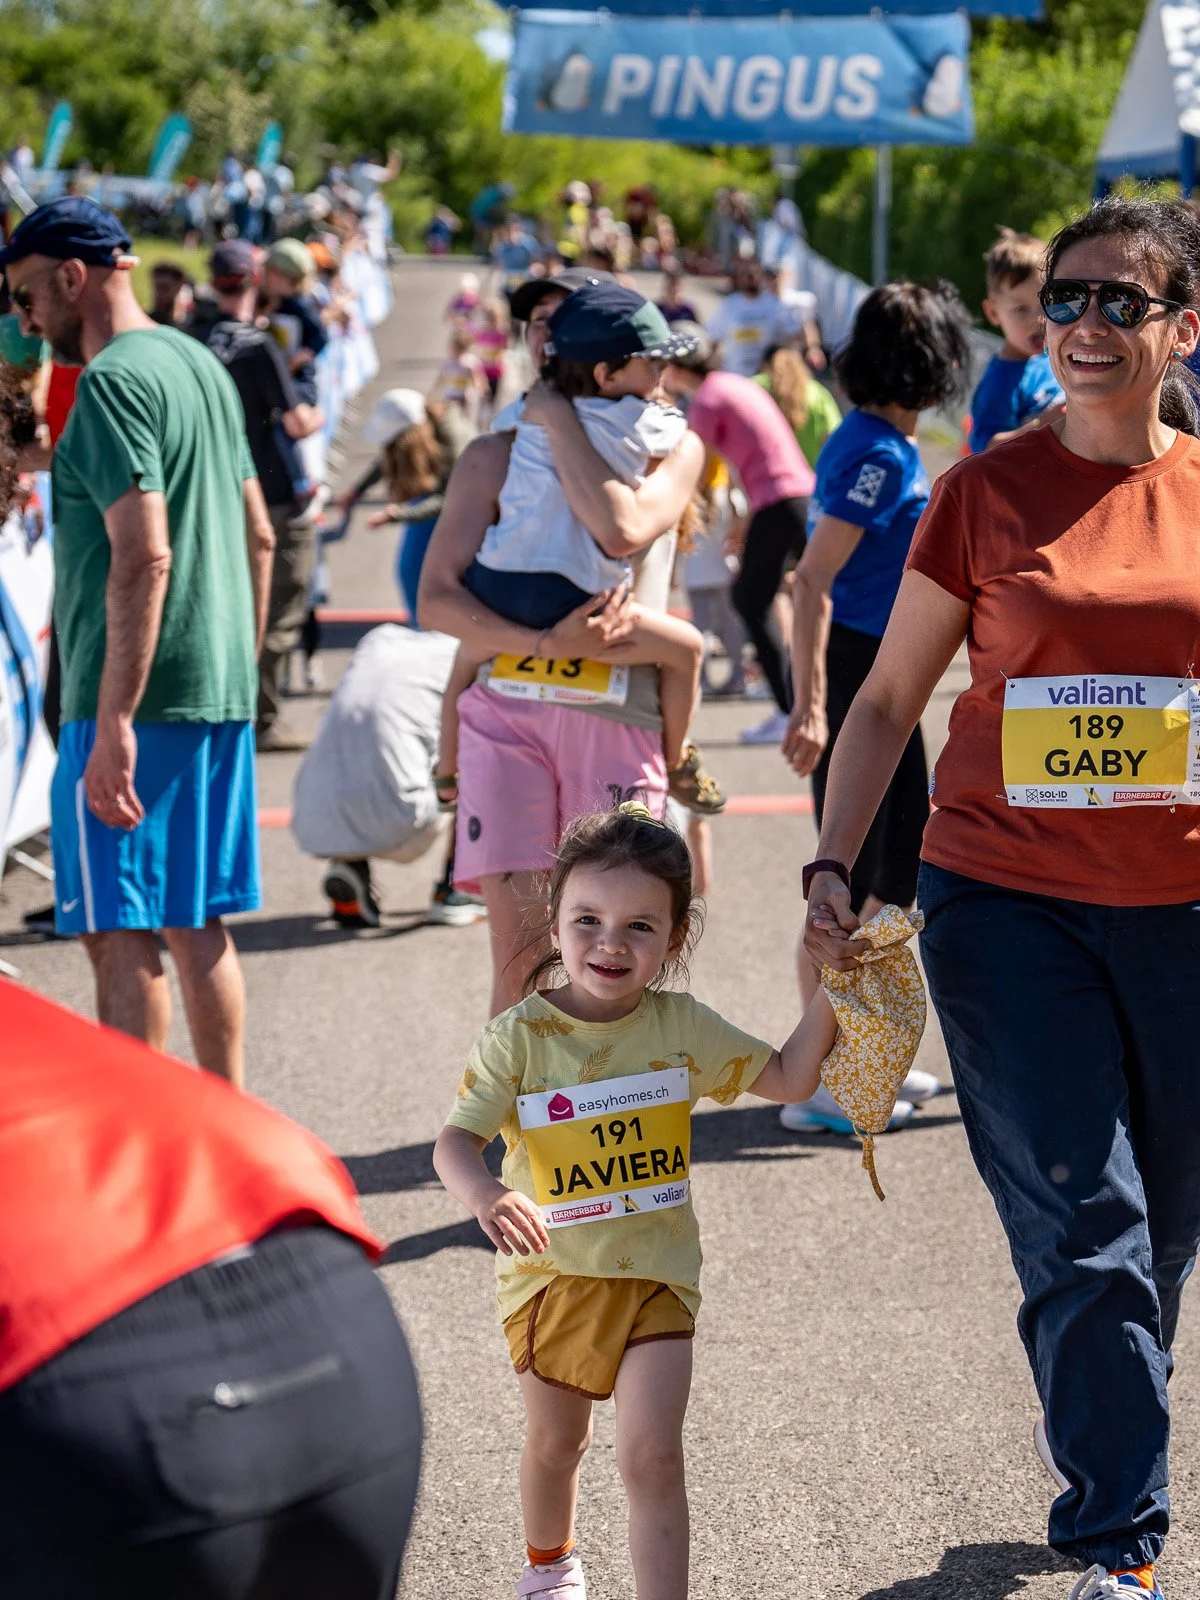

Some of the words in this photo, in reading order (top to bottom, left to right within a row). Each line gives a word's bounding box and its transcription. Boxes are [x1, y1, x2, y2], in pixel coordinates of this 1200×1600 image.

[603, 53, 883, 121] PINGUS
[1047, 678, 1146, 706] valiant
[1068, 715, 1124, 739] 189
[1045, 748, 1147, 777] GABY
[578, 1086, 669, 1112] easyhomes.ch
[590, 1117, 643, 1148] 191
[549, 1145, 686, 1197] JAVIERA
